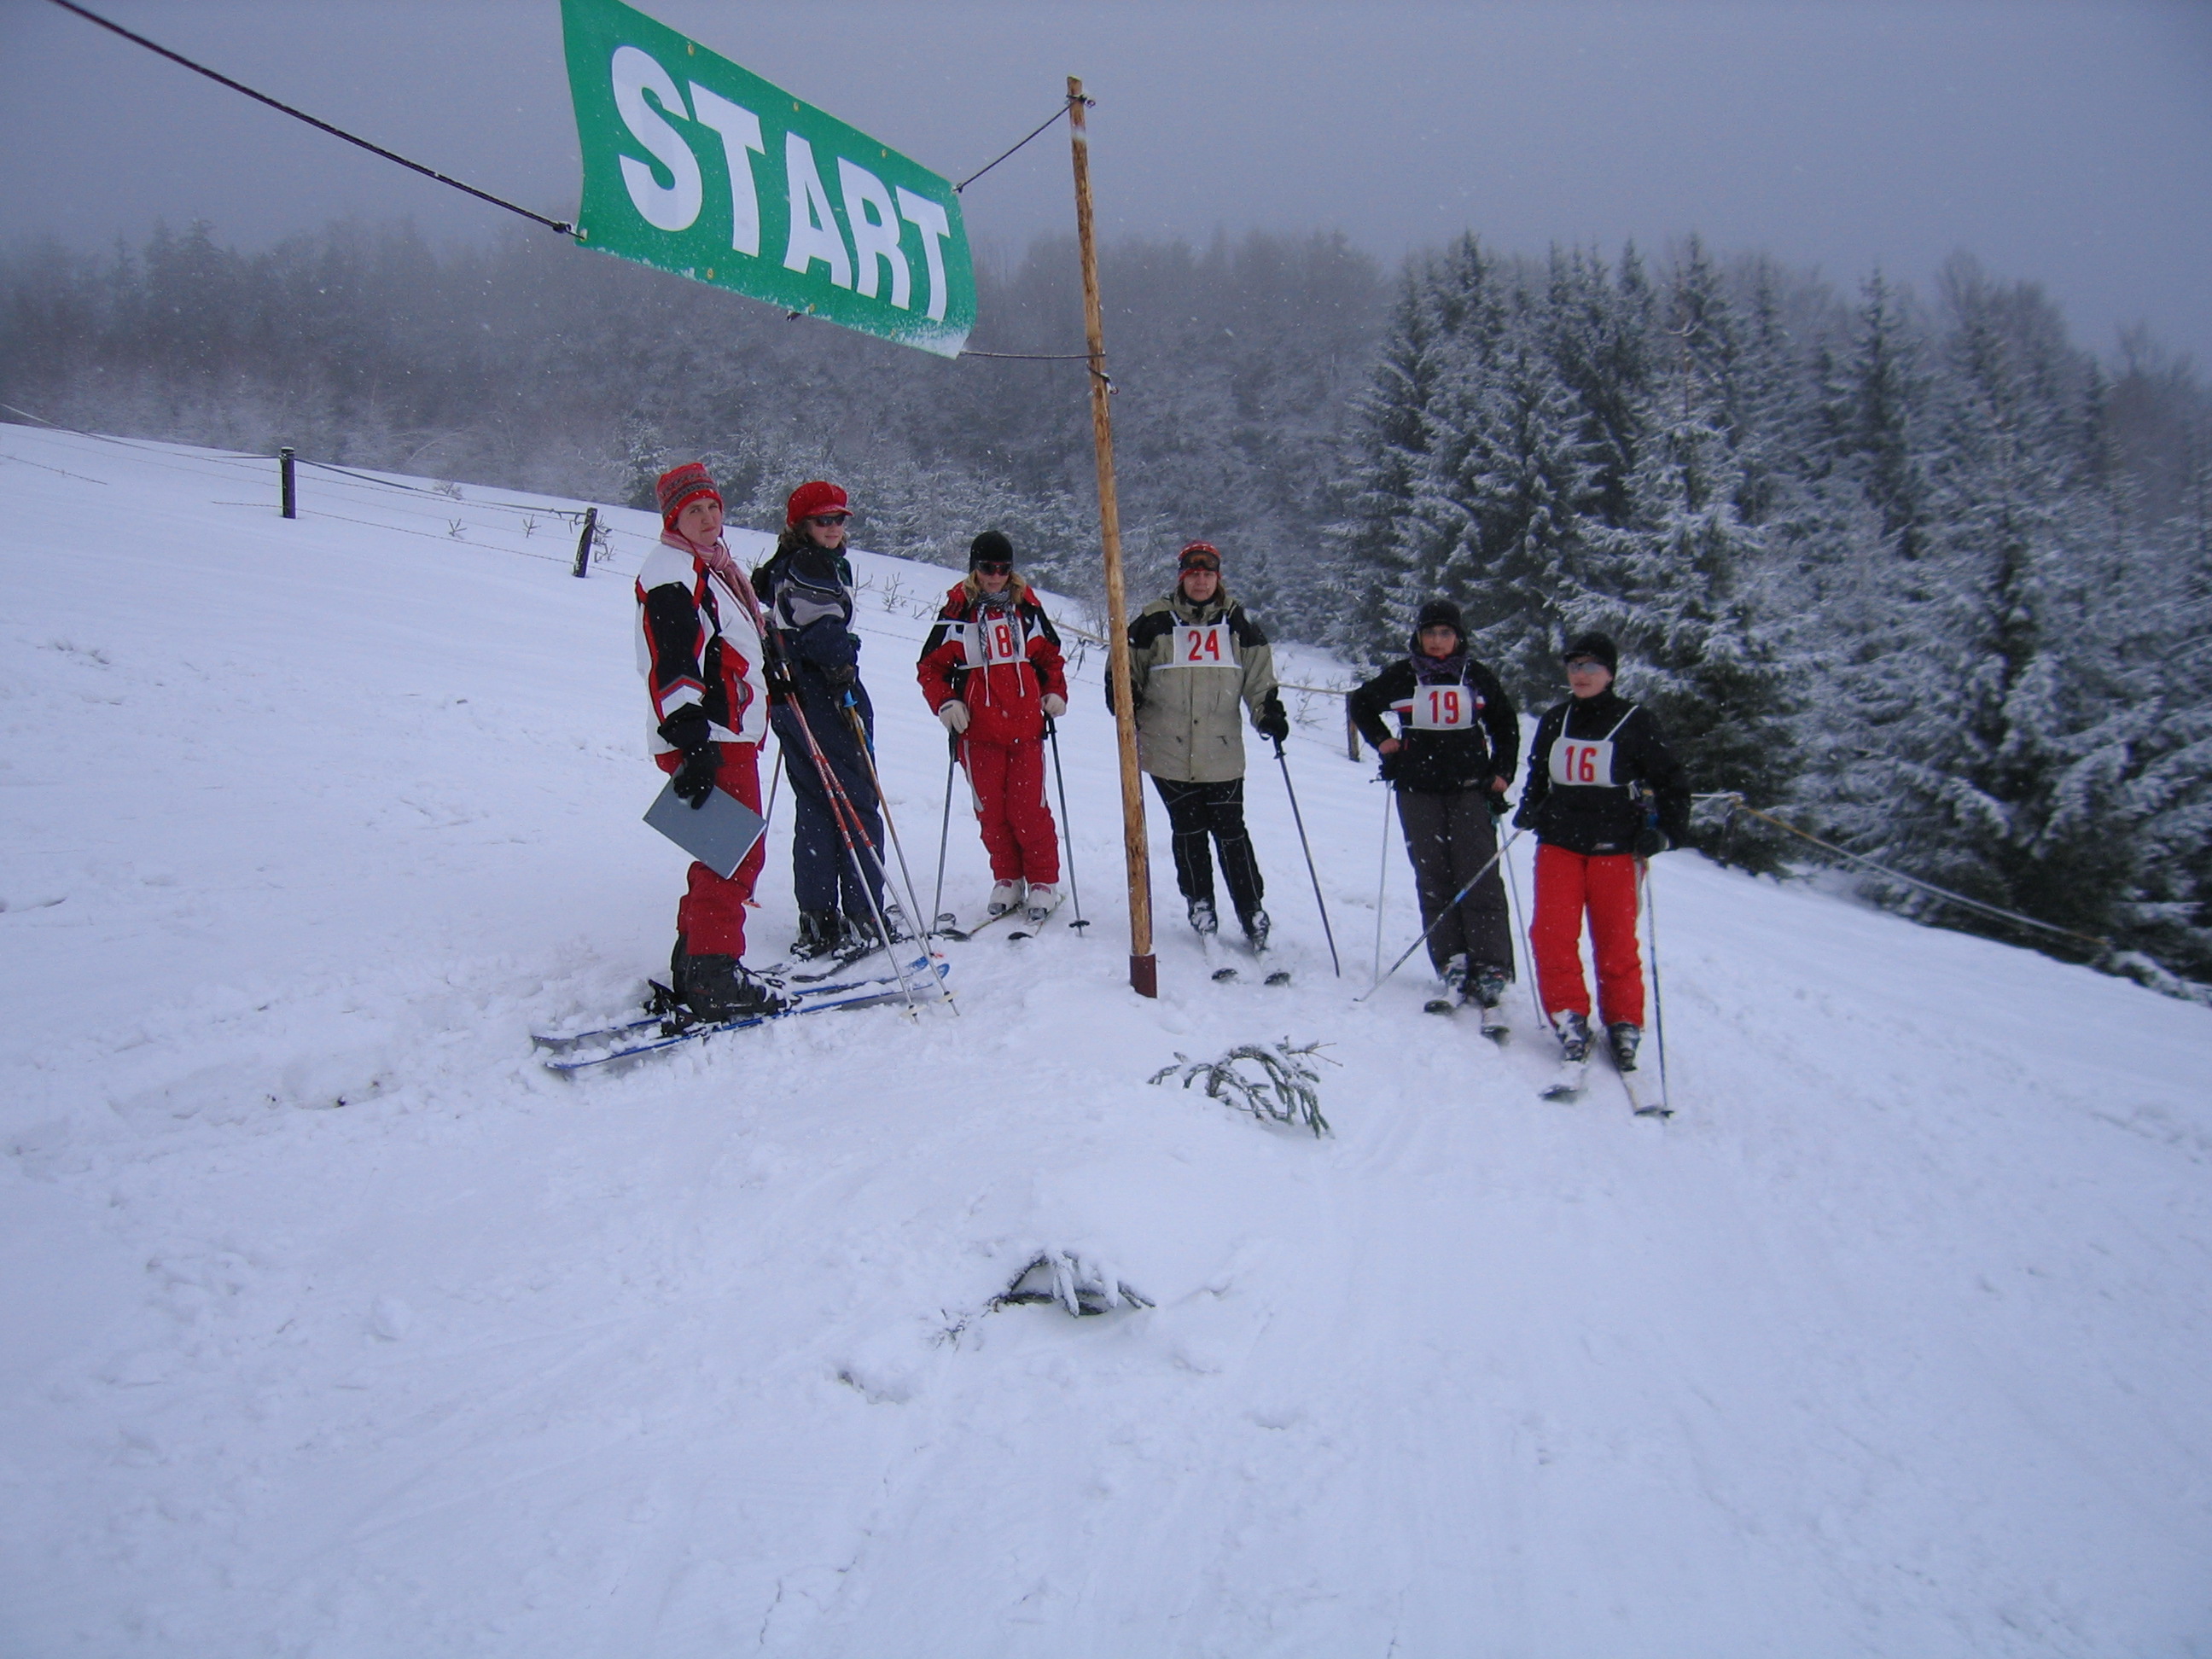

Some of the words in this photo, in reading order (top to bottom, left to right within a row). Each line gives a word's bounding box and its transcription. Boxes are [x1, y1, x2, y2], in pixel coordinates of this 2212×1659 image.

[611, 45, 951, 322] START
[1188, 629, 1220, 661] 24
[1429, 690, 1459, 725] 19
[1565, 745, 1597, 783] 16
